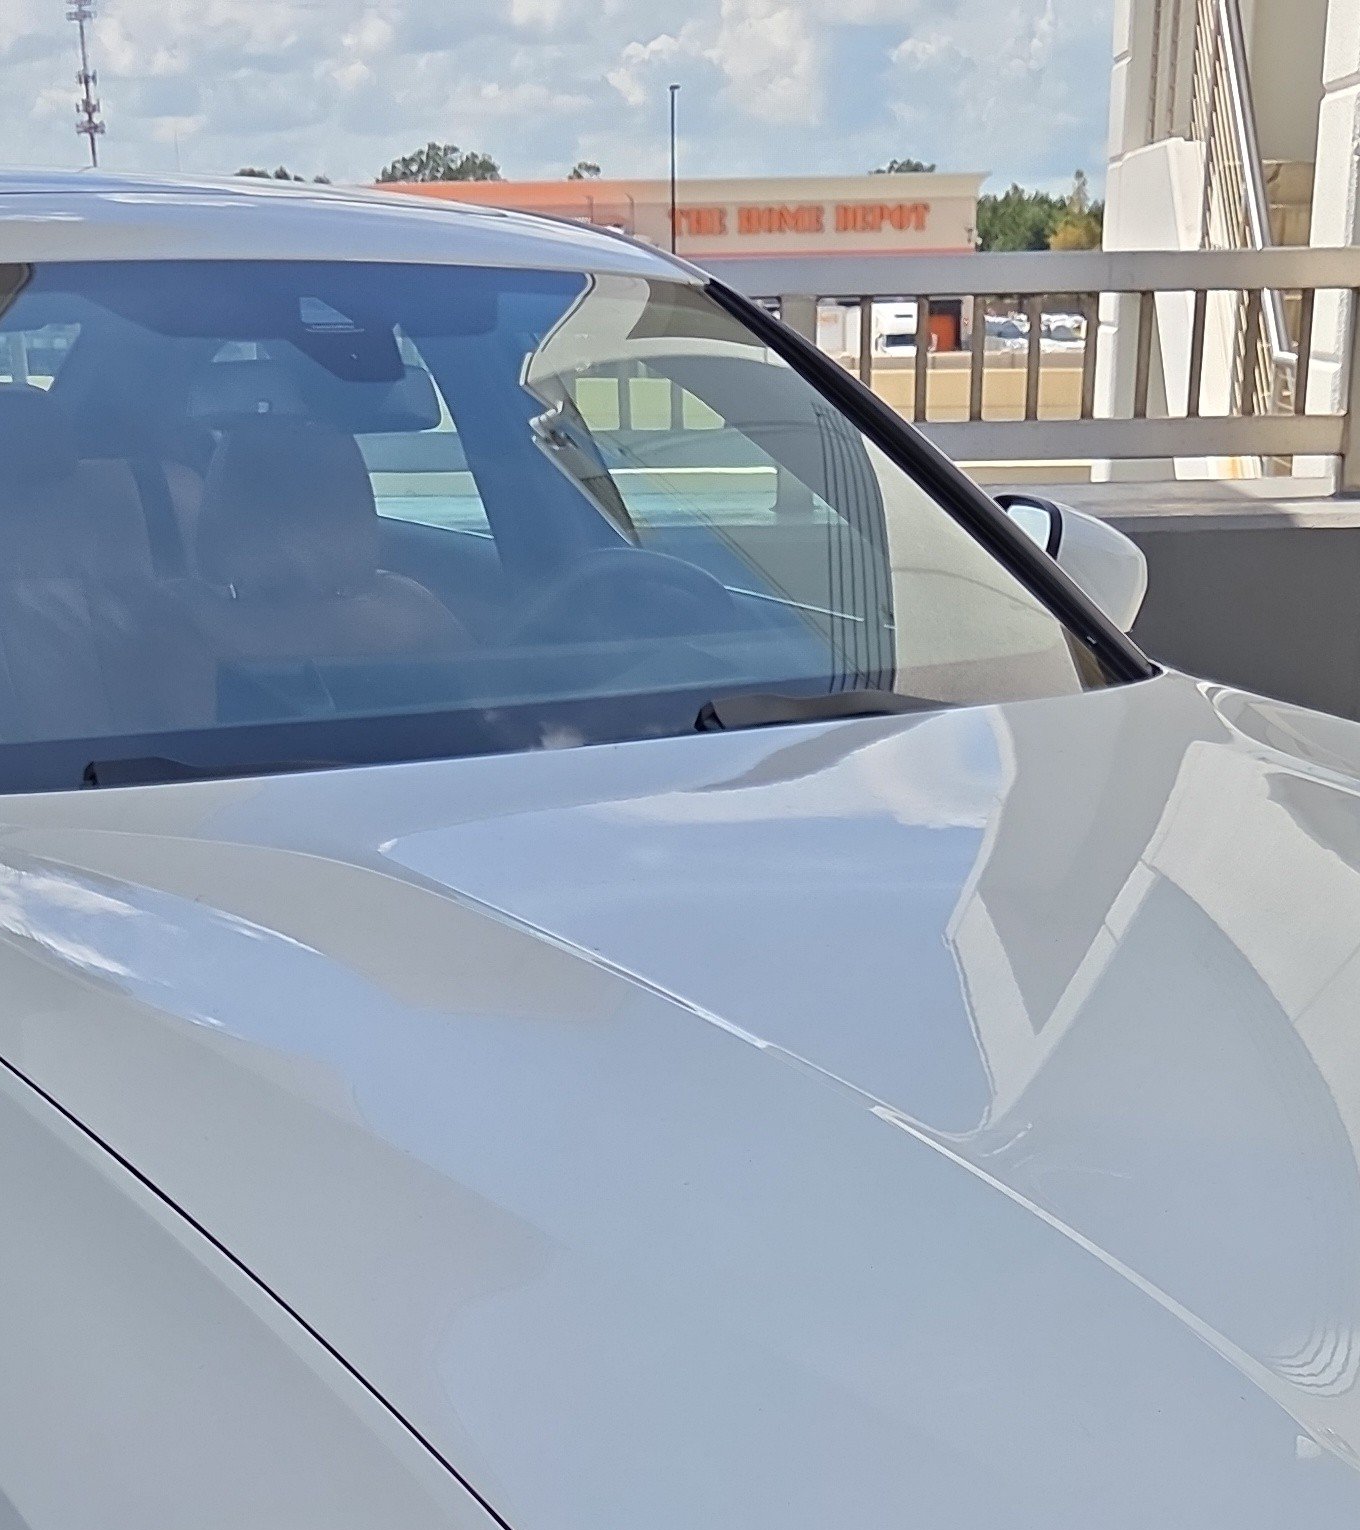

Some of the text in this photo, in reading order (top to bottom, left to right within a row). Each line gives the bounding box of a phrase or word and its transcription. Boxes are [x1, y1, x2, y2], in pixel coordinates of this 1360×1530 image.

[668, 202, 930, 236] THE HOME DEPOT
